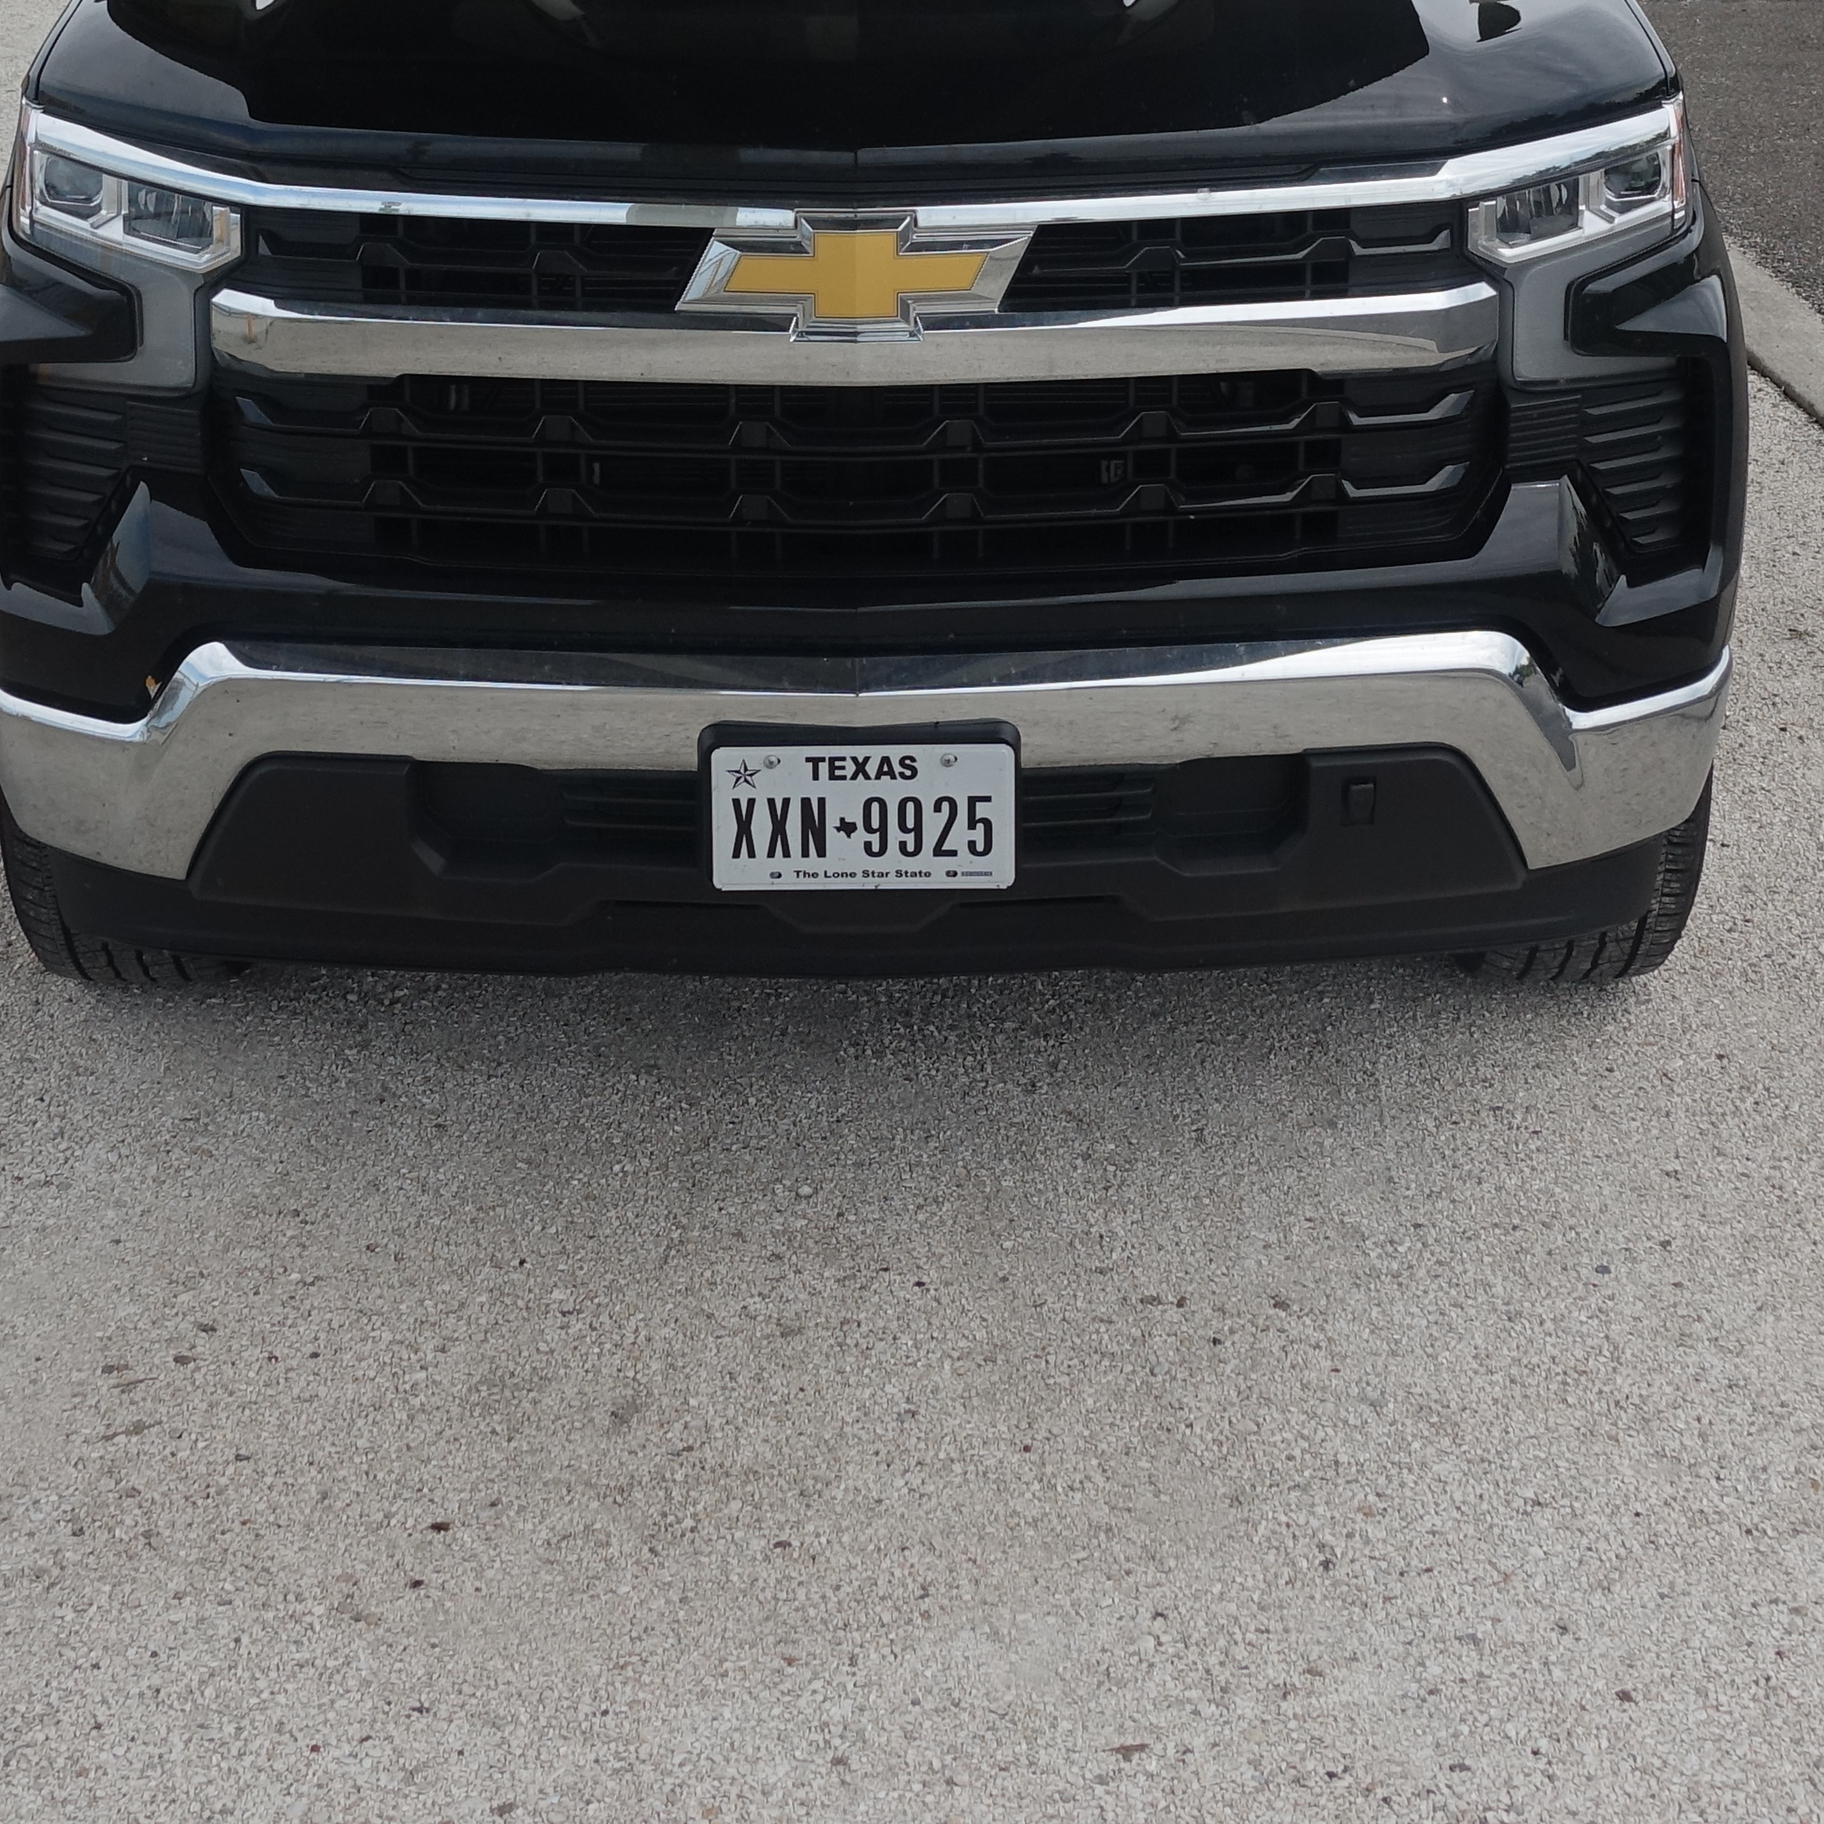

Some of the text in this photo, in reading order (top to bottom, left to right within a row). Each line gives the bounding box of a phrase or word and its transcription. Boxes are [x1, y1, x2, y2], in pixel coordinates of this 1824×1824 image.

[805, 755, 918, 781] TEXAS
[731, 795, 993, 859] XXN 9925
[793, 868, 932, 879] The Lone Star State
